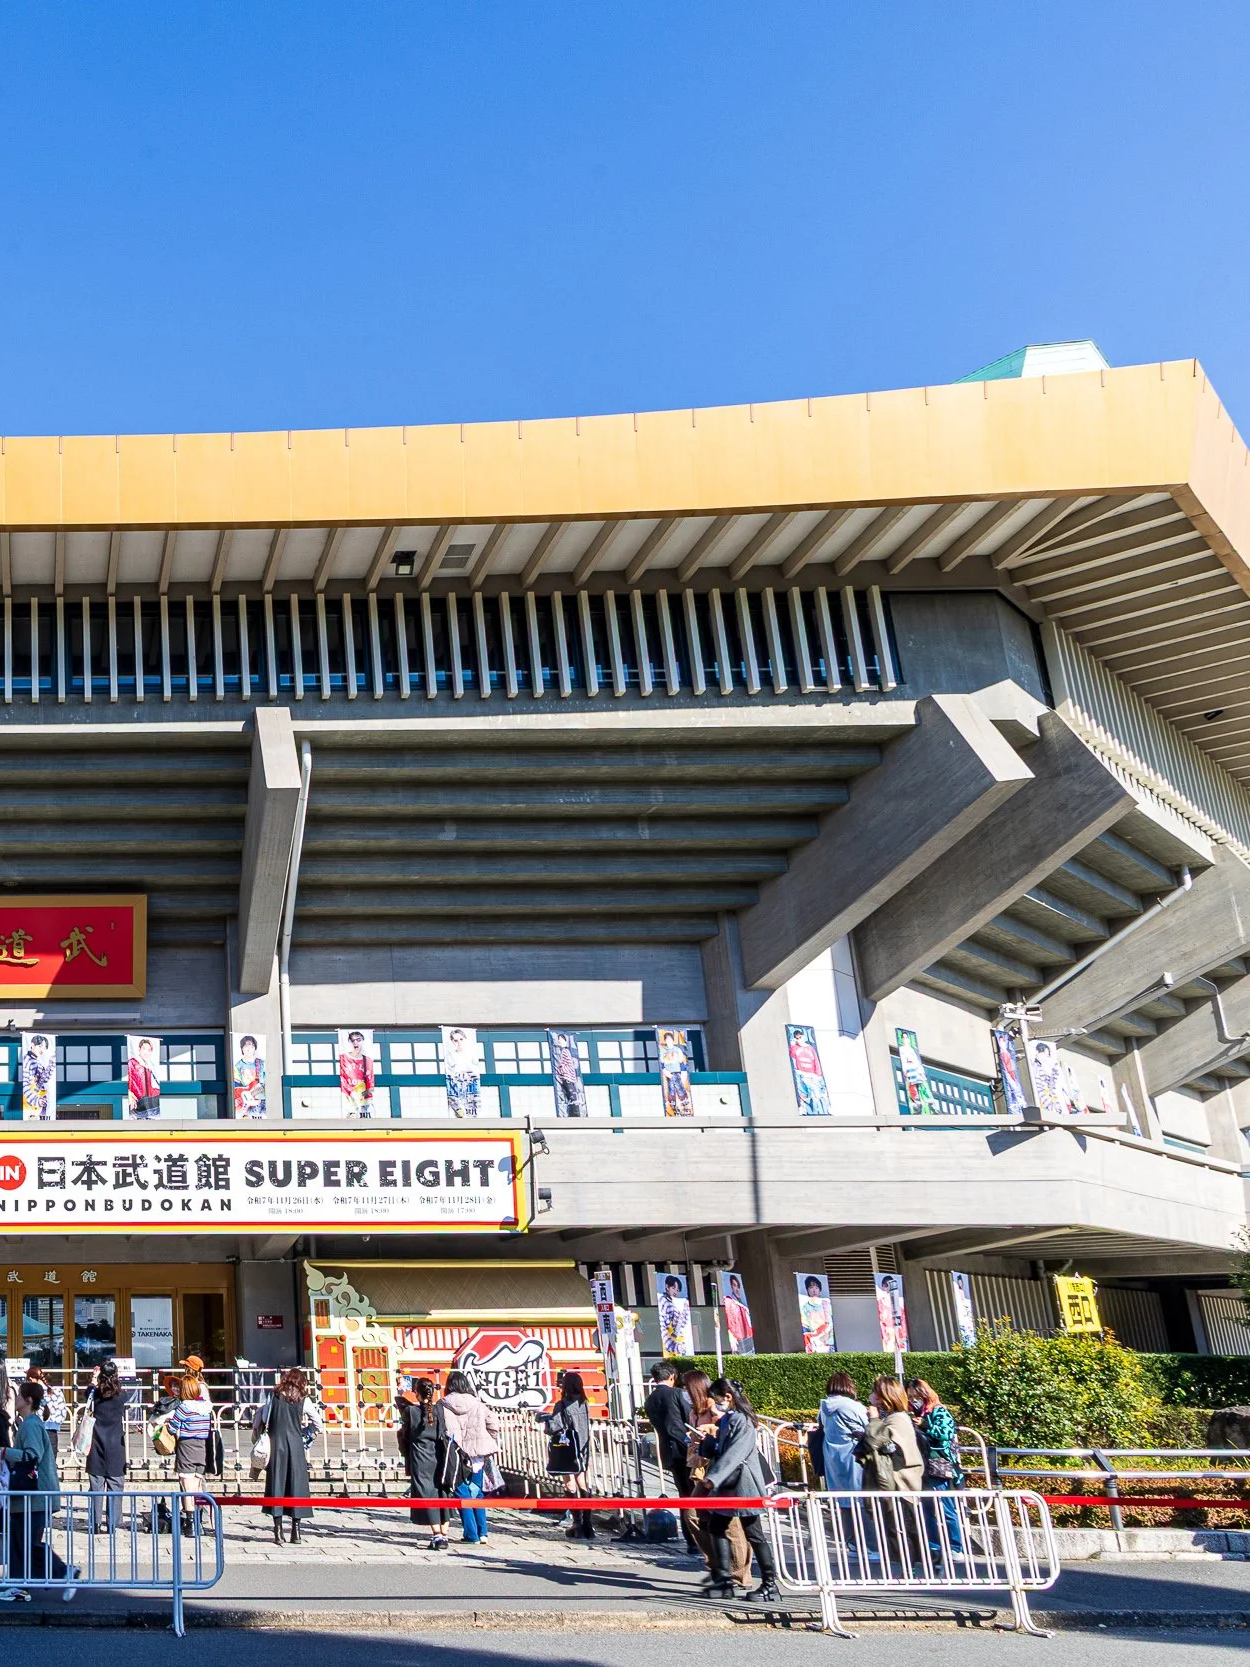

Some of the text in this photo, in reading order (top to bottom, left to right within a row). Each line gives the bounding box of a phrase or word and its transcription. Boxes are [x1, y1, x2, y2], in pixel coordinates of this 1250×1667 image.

[38, 1154, 231, 1192] 日本武道館
[245, 1159, 495, 1188] SUPER EIGHT
